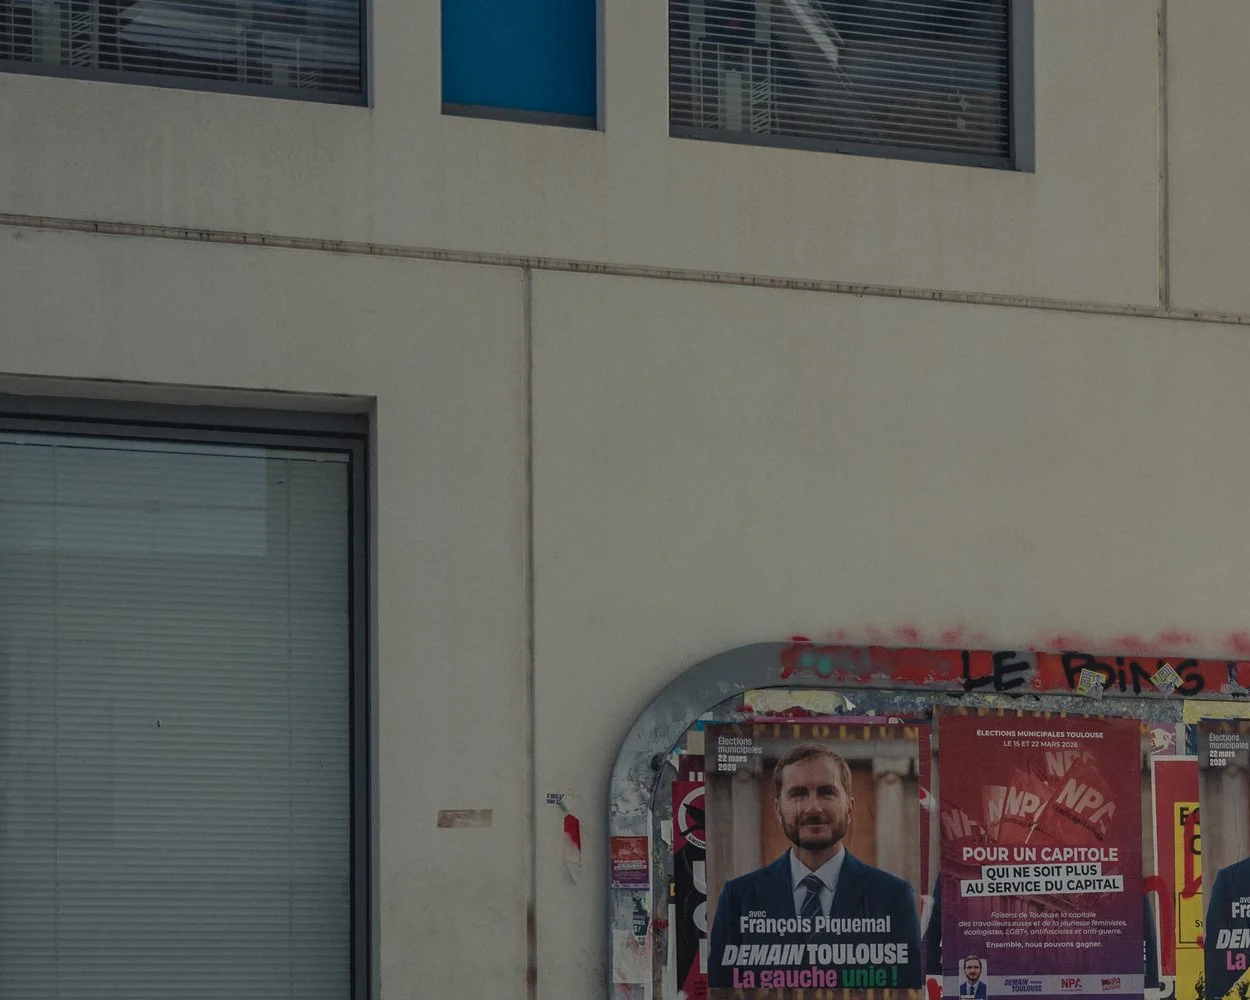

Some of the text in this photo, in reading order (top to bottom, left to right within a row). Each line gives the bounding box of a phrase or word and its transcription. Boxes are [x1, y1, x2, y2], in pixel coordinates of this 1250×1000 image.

[960, 650, 1029, 692] LE
[977, 729, 1017, 738] ÉLECTIONS
[1018, 731, 1065, 739] MUNICIPALES
[1209, 733, 1240, 741] Élections
[718, 736, 752, 745] Élections
[1031, 740, 1040, 748] 22
[718, 745, 763, 754] municipales
[1209, 741, 1249, 750] municipales
[1209, 750, 1218, 758] 22
[718, 755, 728, 763] 22
[1209, 758, 1226, 766] 2026
[718, 763, 737, 771] 2026
[962, 847, 1119, 861] POUR UN CAPITOLE
[986, 865, 1097, 878] QUI NE SOIT PLUS
[966, 878, 1120, 894] AU SERVICE DU CAPITAL
[749, 910, 767, 918] avec
[1068, 911, 1096, 920] capitale
[740, 915, 891, 936] François Piquemal
[1059, 920, 1090, 929] jeunesse
[1030, 928, 1073, 936] antifascistes
[986, 941, 1024, 949] Ensemble,
[1044, 942, 1074, 950] pouvons
[1075, 941, 1103, 950] gagner.
[721, 943, 908, 966] DEMAIN TOULOUSE
[1226, 950, 1246, 971] La
[732, 966, 887, 989] La gauche unie
[1061, 978, 1082, 988] NPA
